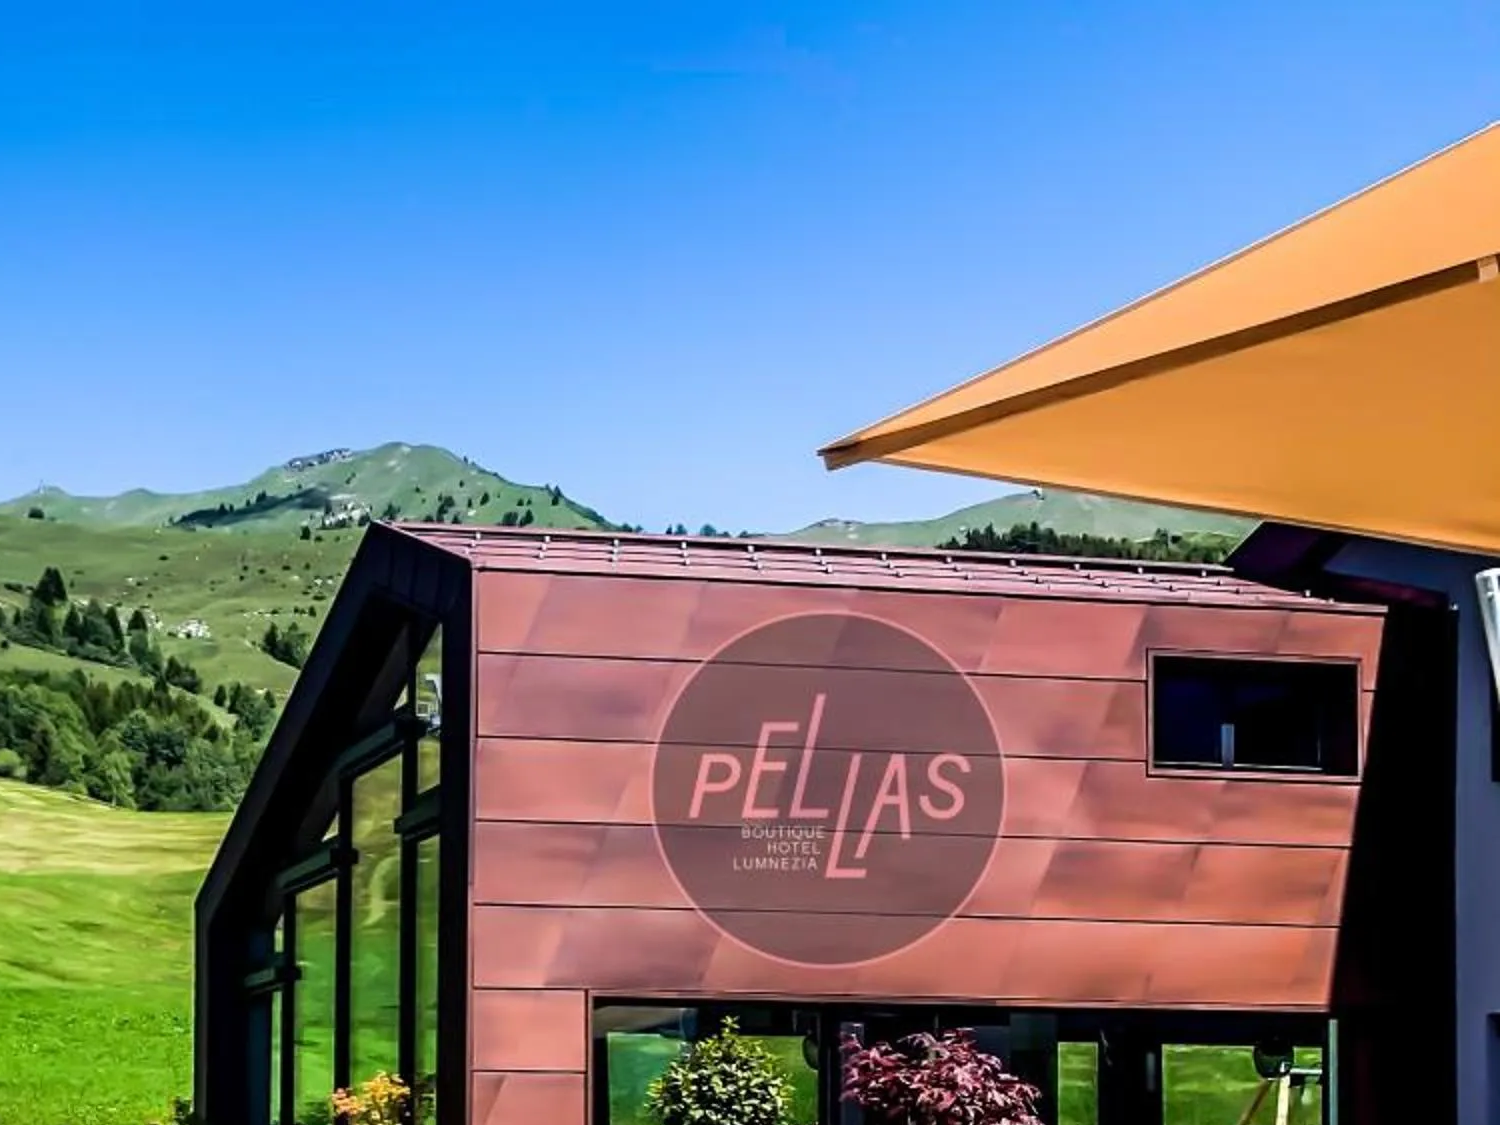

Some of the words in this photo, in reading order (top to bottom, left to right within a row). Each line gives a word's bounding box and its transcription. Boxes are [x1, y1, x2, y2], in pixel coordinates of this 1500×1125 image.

[689, 693, 971, 878] PELLAS
[741, 825, 826, 839] BOUTIQUE
[767, 841, 820, 855] HOTEL
[733, 857, 818, 871] LUMNEZIA
